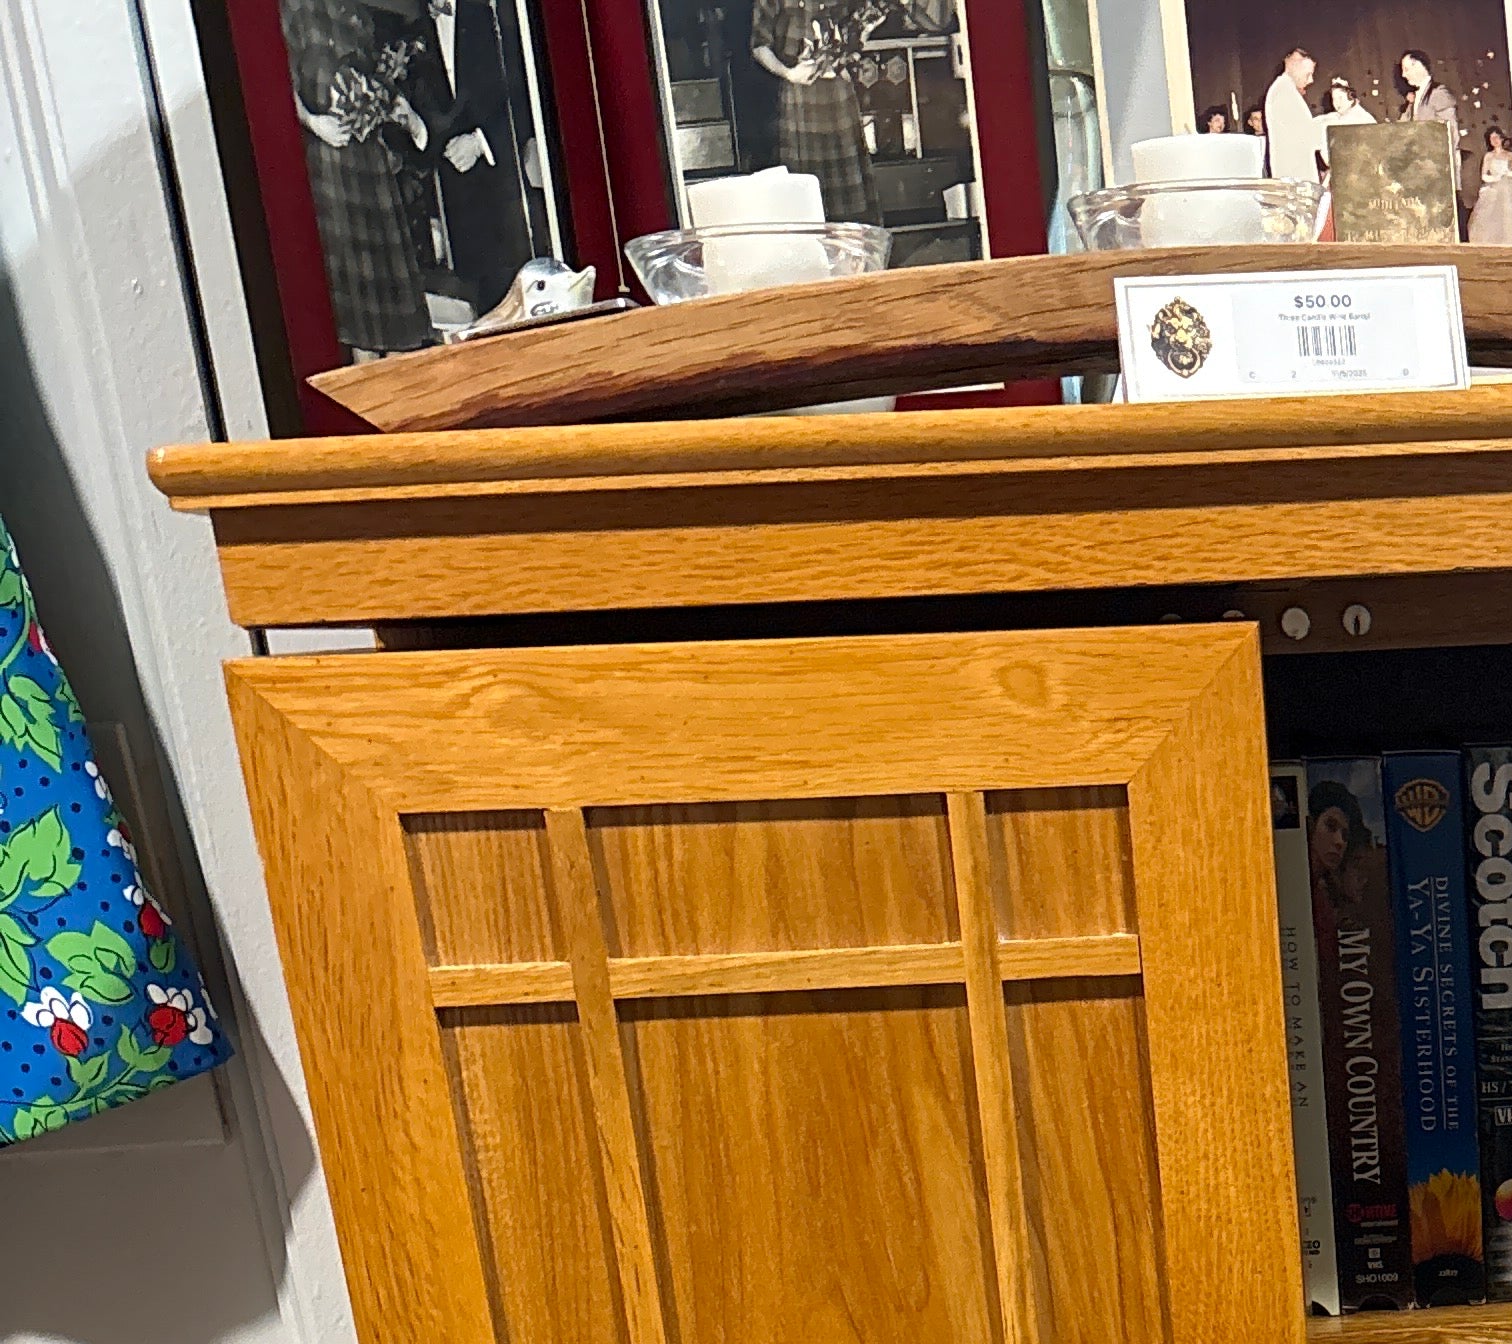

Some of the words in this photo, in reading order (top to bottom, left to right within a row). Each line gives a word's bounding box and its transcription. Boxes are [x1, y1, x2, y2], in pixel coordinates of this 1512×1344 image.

[1294, 294, 1352, 308] $50.00
[1337, 928, 1370, 974] MY
[1408, 881, 1432, 955] YA-YA
[1340, 982, 1373, 1049] OWN
[1412, 966, 1436, 1132] SISTERHOOD
[1345, 1056, 1381, 1185] COUNTRY
